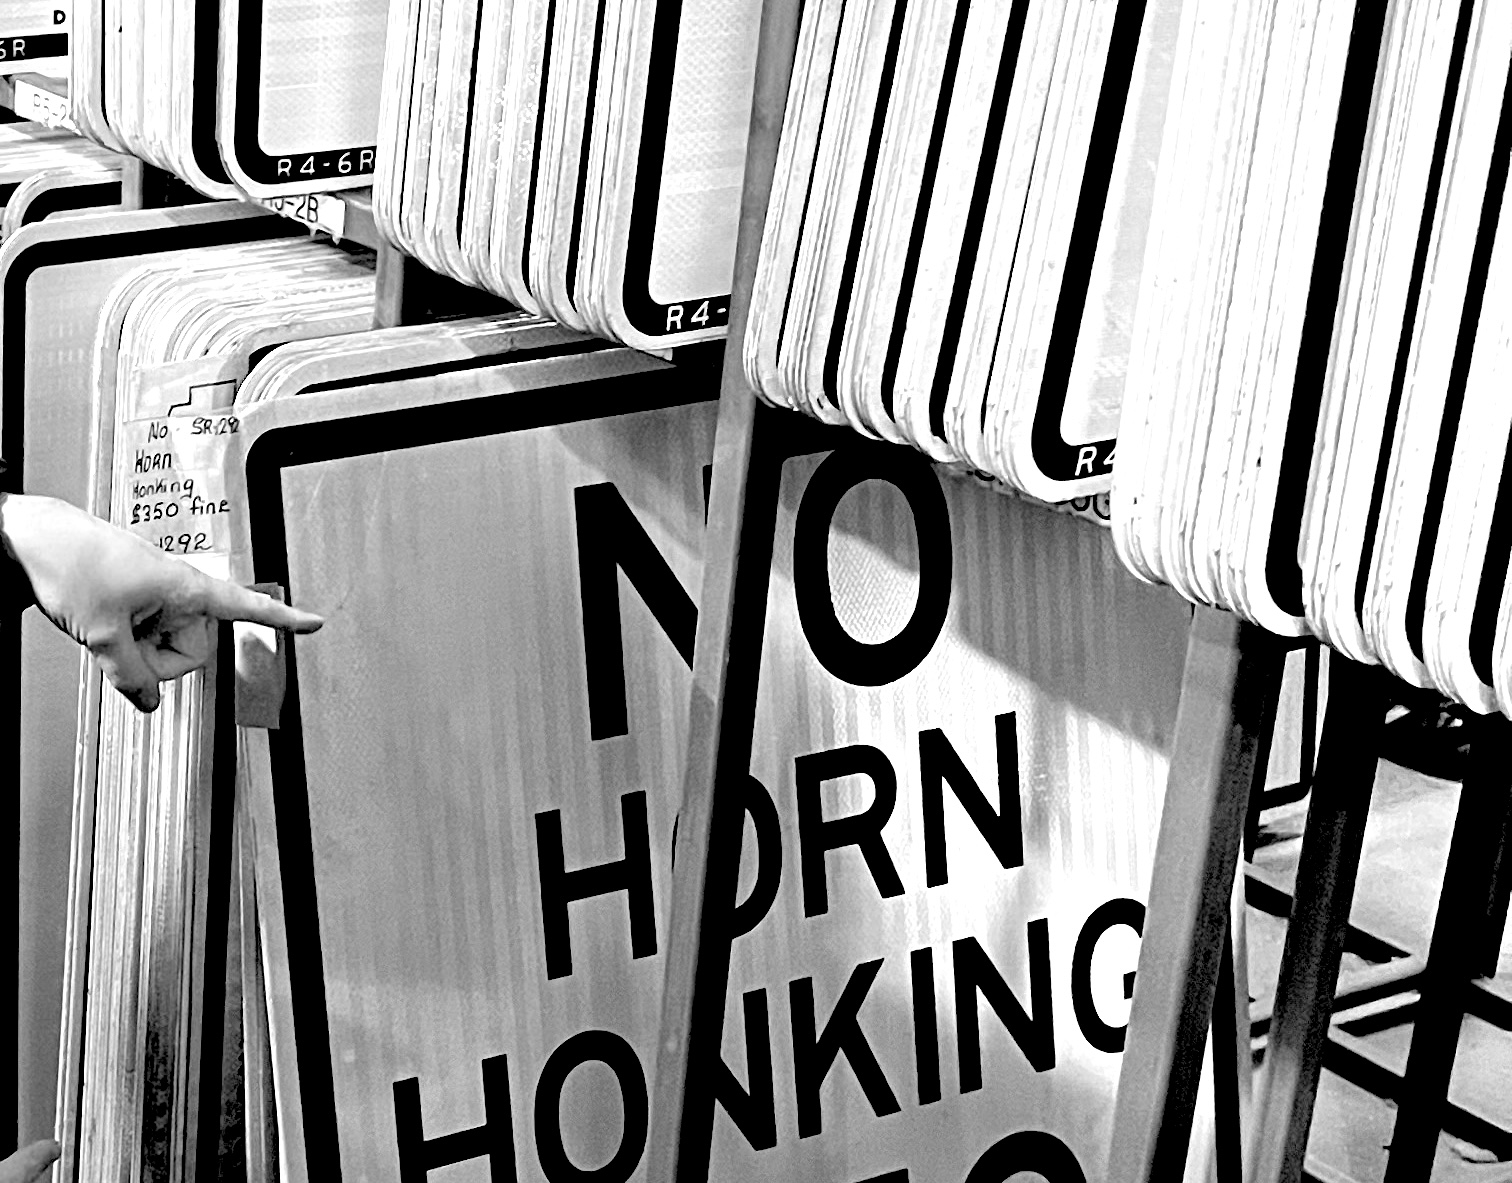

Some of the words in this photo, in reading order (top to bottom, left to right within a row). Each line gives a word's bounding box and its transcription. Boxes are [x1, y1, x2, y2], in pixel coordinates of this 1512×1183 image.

[277, 150, 374, 176] R4-6R
[148, 421, 168, 443] No
[130, 502, 179, 525] $350
[574, 440, 953, 741] NO
